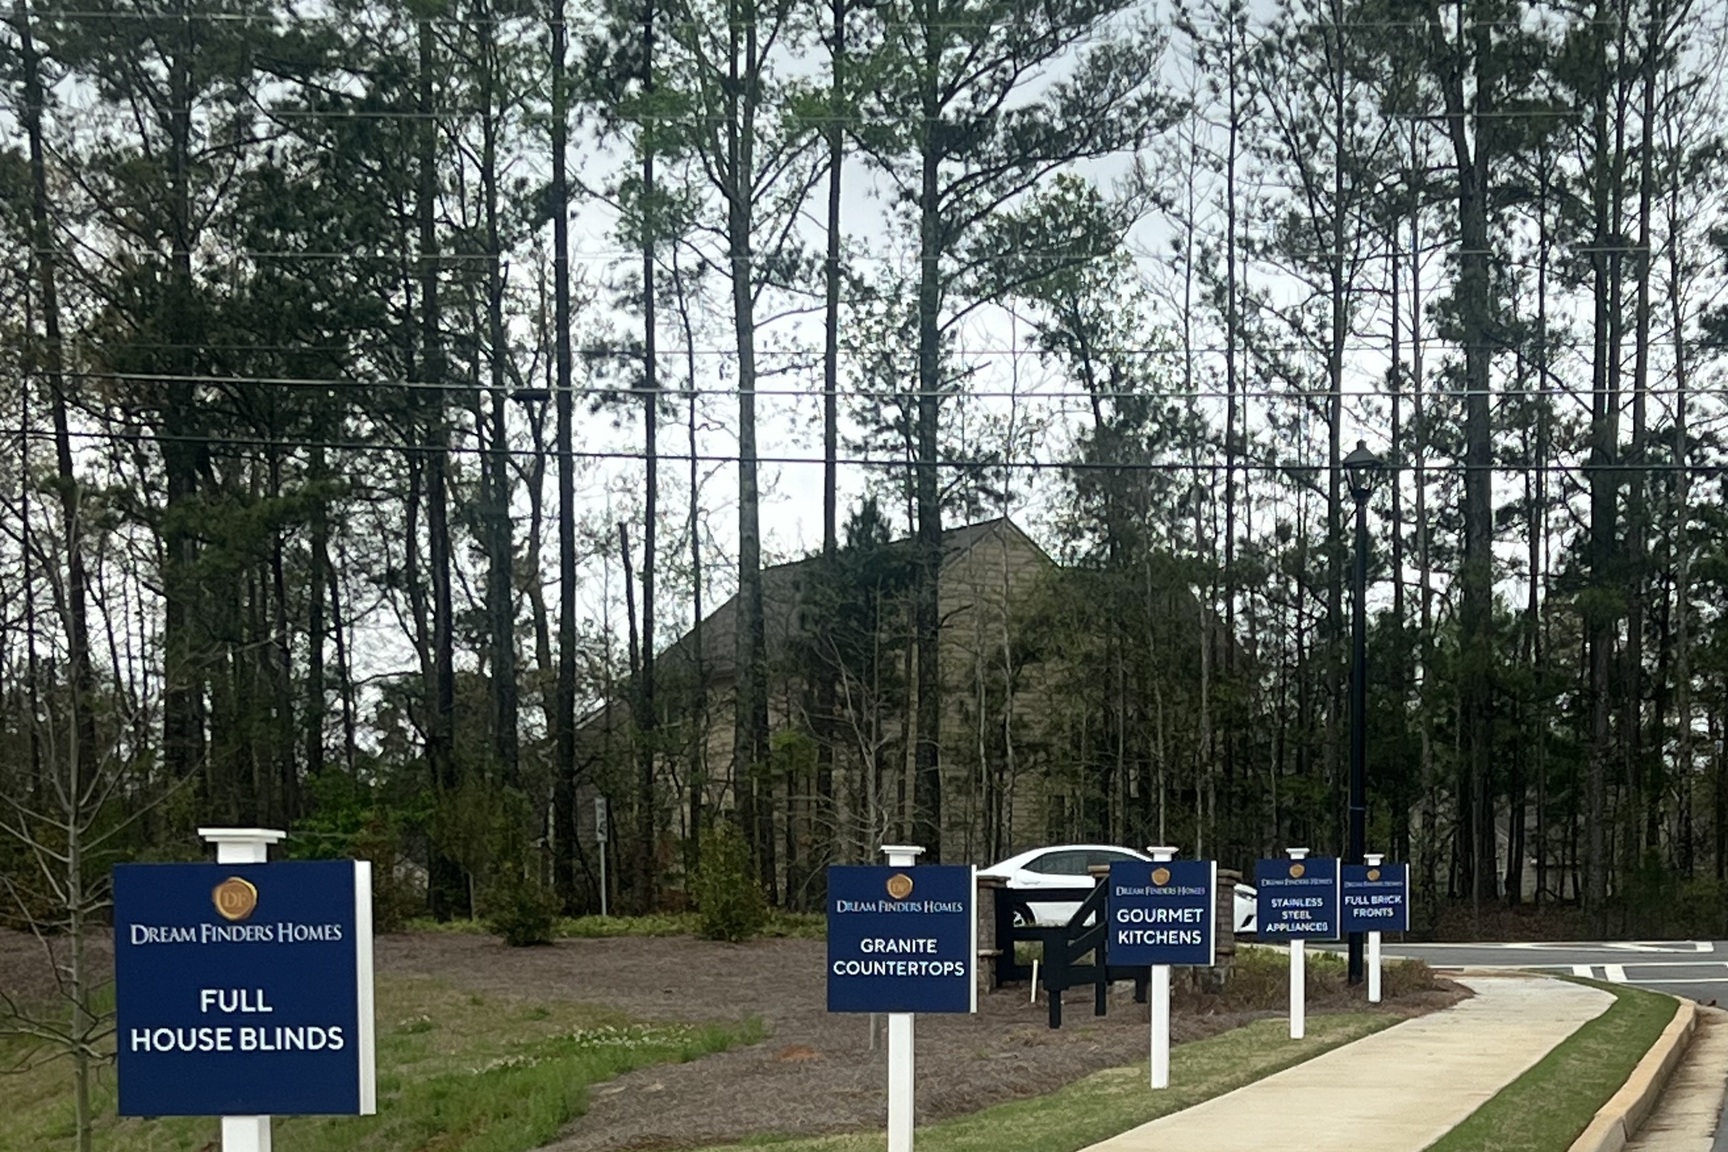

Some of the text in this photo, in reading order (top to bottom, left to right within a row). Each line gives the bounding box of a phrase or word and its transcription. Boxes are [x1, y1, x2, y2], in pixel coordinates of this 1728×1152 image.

[836, 900, 877, 913] DREAM
[924, 900, 963, 913] HOMES
[1271, 897, 1323, 908] STAINLESS
[1345, 895, 1402, 905] FULL BRICK
[1116, 908, 1204, 923] GOURMET
[1282, 910, 1312, 920] STEEL
[1353, 908, 1394, 917] FRONTS
[130, 922, 342, 945] DREAM FINDERS HOMES
[1266, 922, 1328, 932] APPLIANCES
[1118, 930, 1202, 945] KITCHENS
[860, 938, 938, 954] GRANITE
[833, 960, 965, 977] COUNTERTOPS
[200, 989, 273, 1013] FULL
[131, 1026, 344, 1052] HOUSE BLINDS
